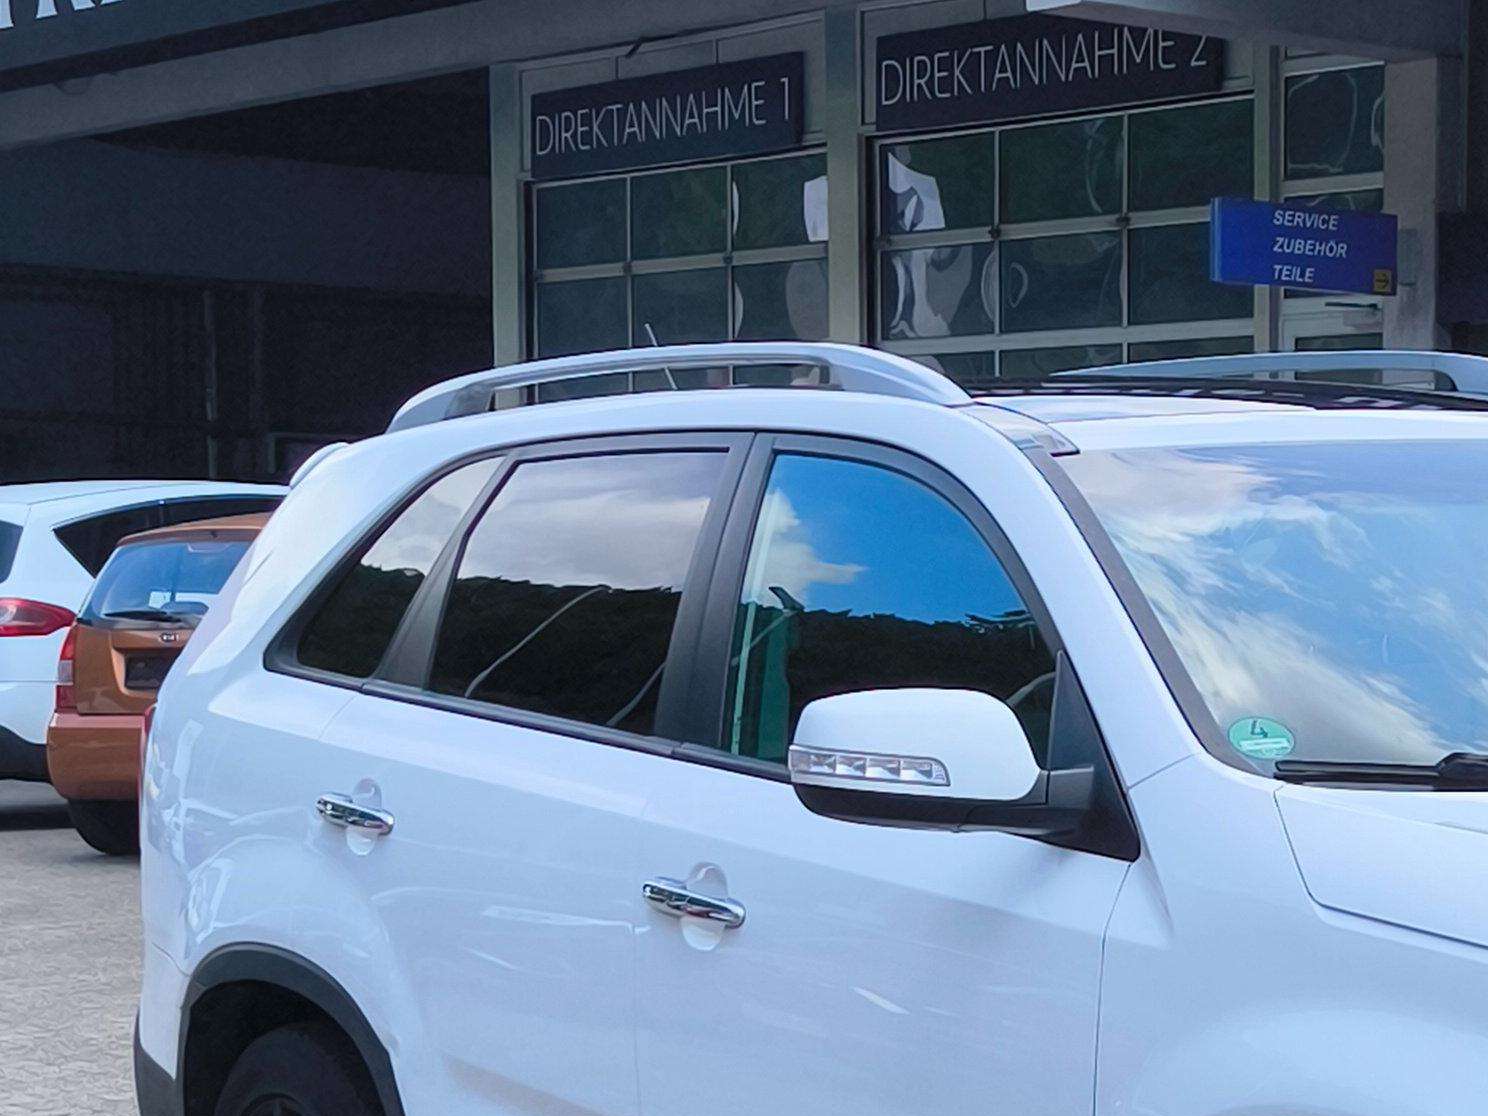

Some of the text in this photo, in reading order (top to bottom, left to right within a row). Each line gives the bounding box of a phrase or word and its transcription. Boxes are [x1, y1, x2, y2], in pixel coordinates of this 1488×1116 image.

[881, 26, 1208, 106] DIREKTANNAHME 2
[536, 77, 789, 155] DIREKTANNAHME 1
[1273, 210, 1339, 230] SERVICE
[1273, 237, 1348, 258] ZUBEHÖR
[1274, 264, 1315, 282] TEILE
[1250, 720, 1268, 738] 4
